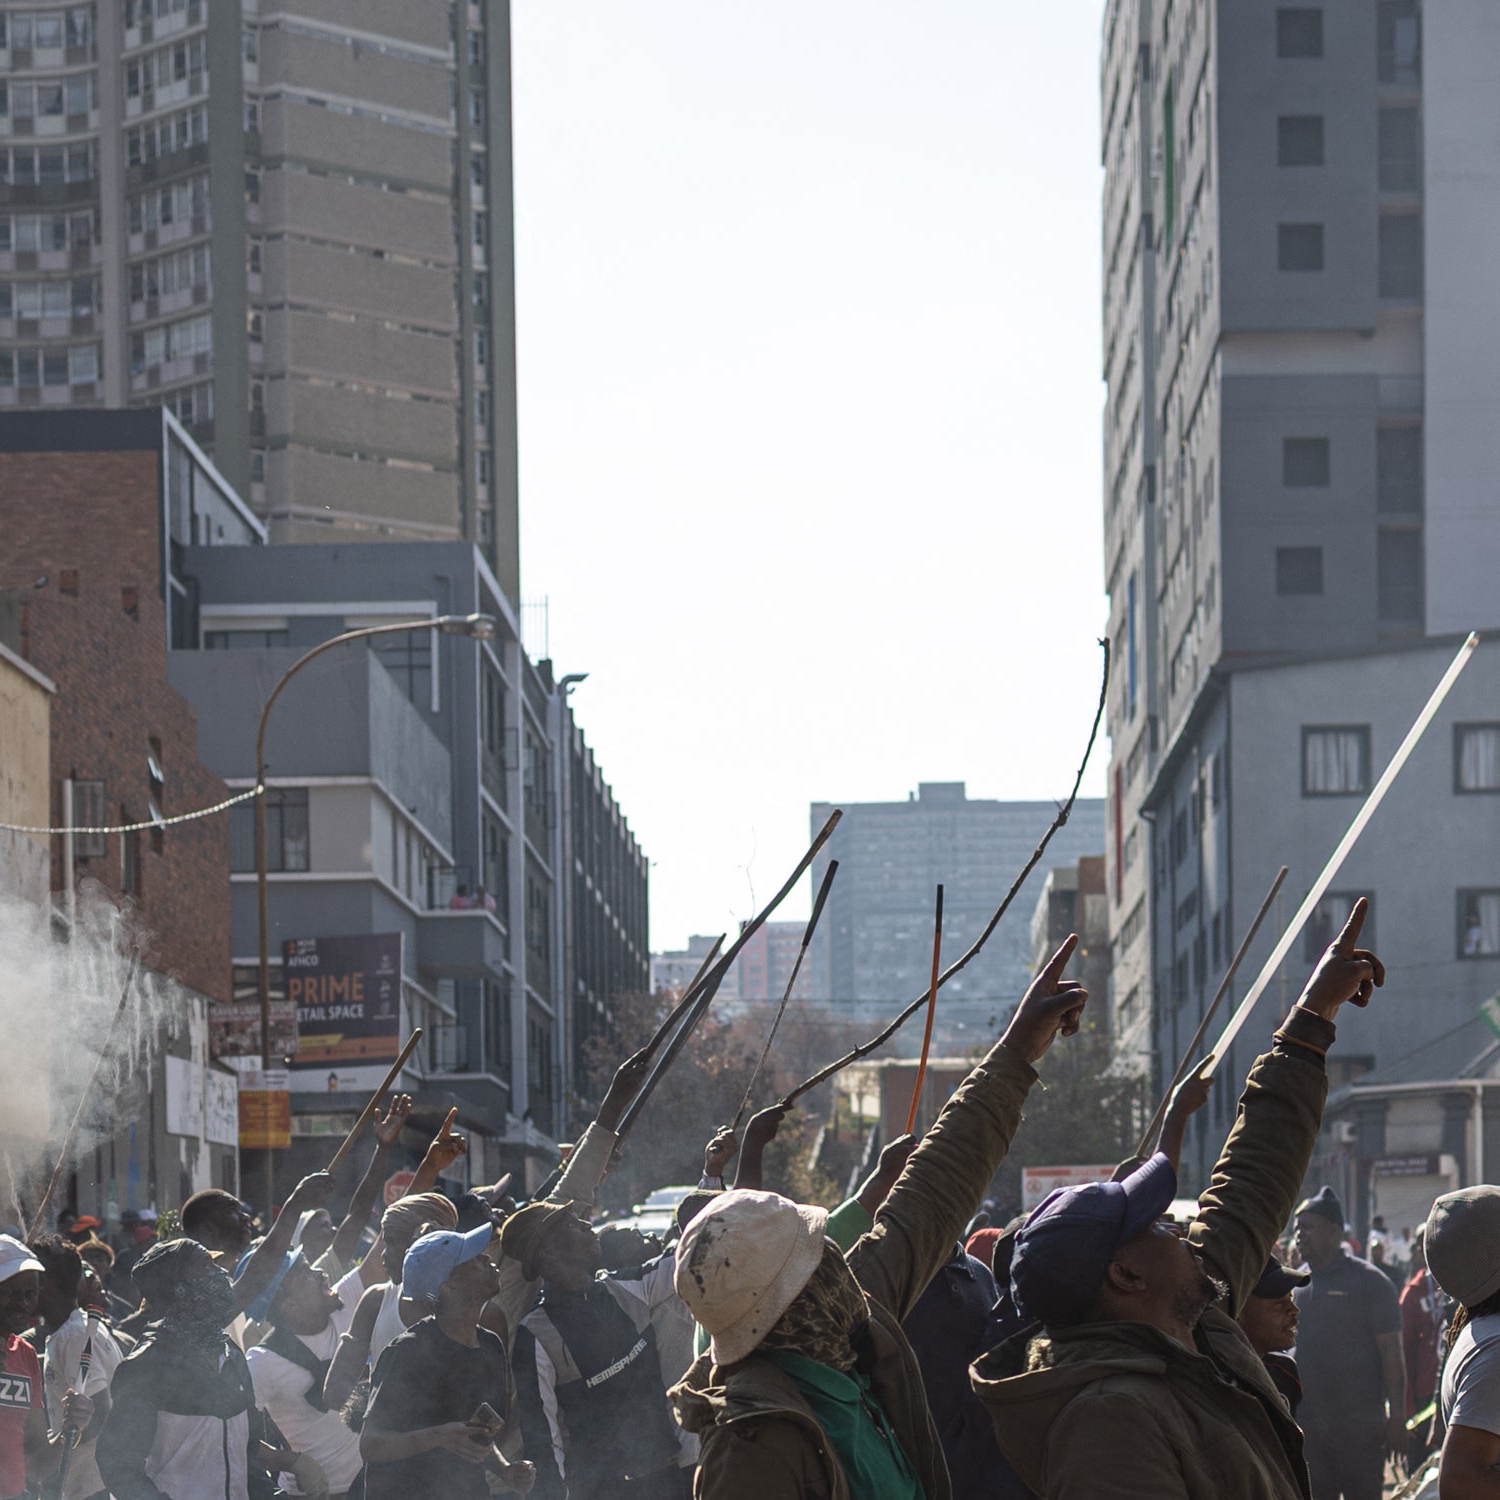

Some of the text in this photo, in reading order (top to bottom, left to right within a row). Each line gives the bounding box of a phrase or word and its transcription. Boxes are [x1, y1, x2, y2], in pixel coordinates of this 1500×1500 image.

[288, 972, 365, 1006] PRIME
[297, 1003, 364, 1022] ETAIL SPACE
[586, 1338, 648, 1388] HEMISPHERE
